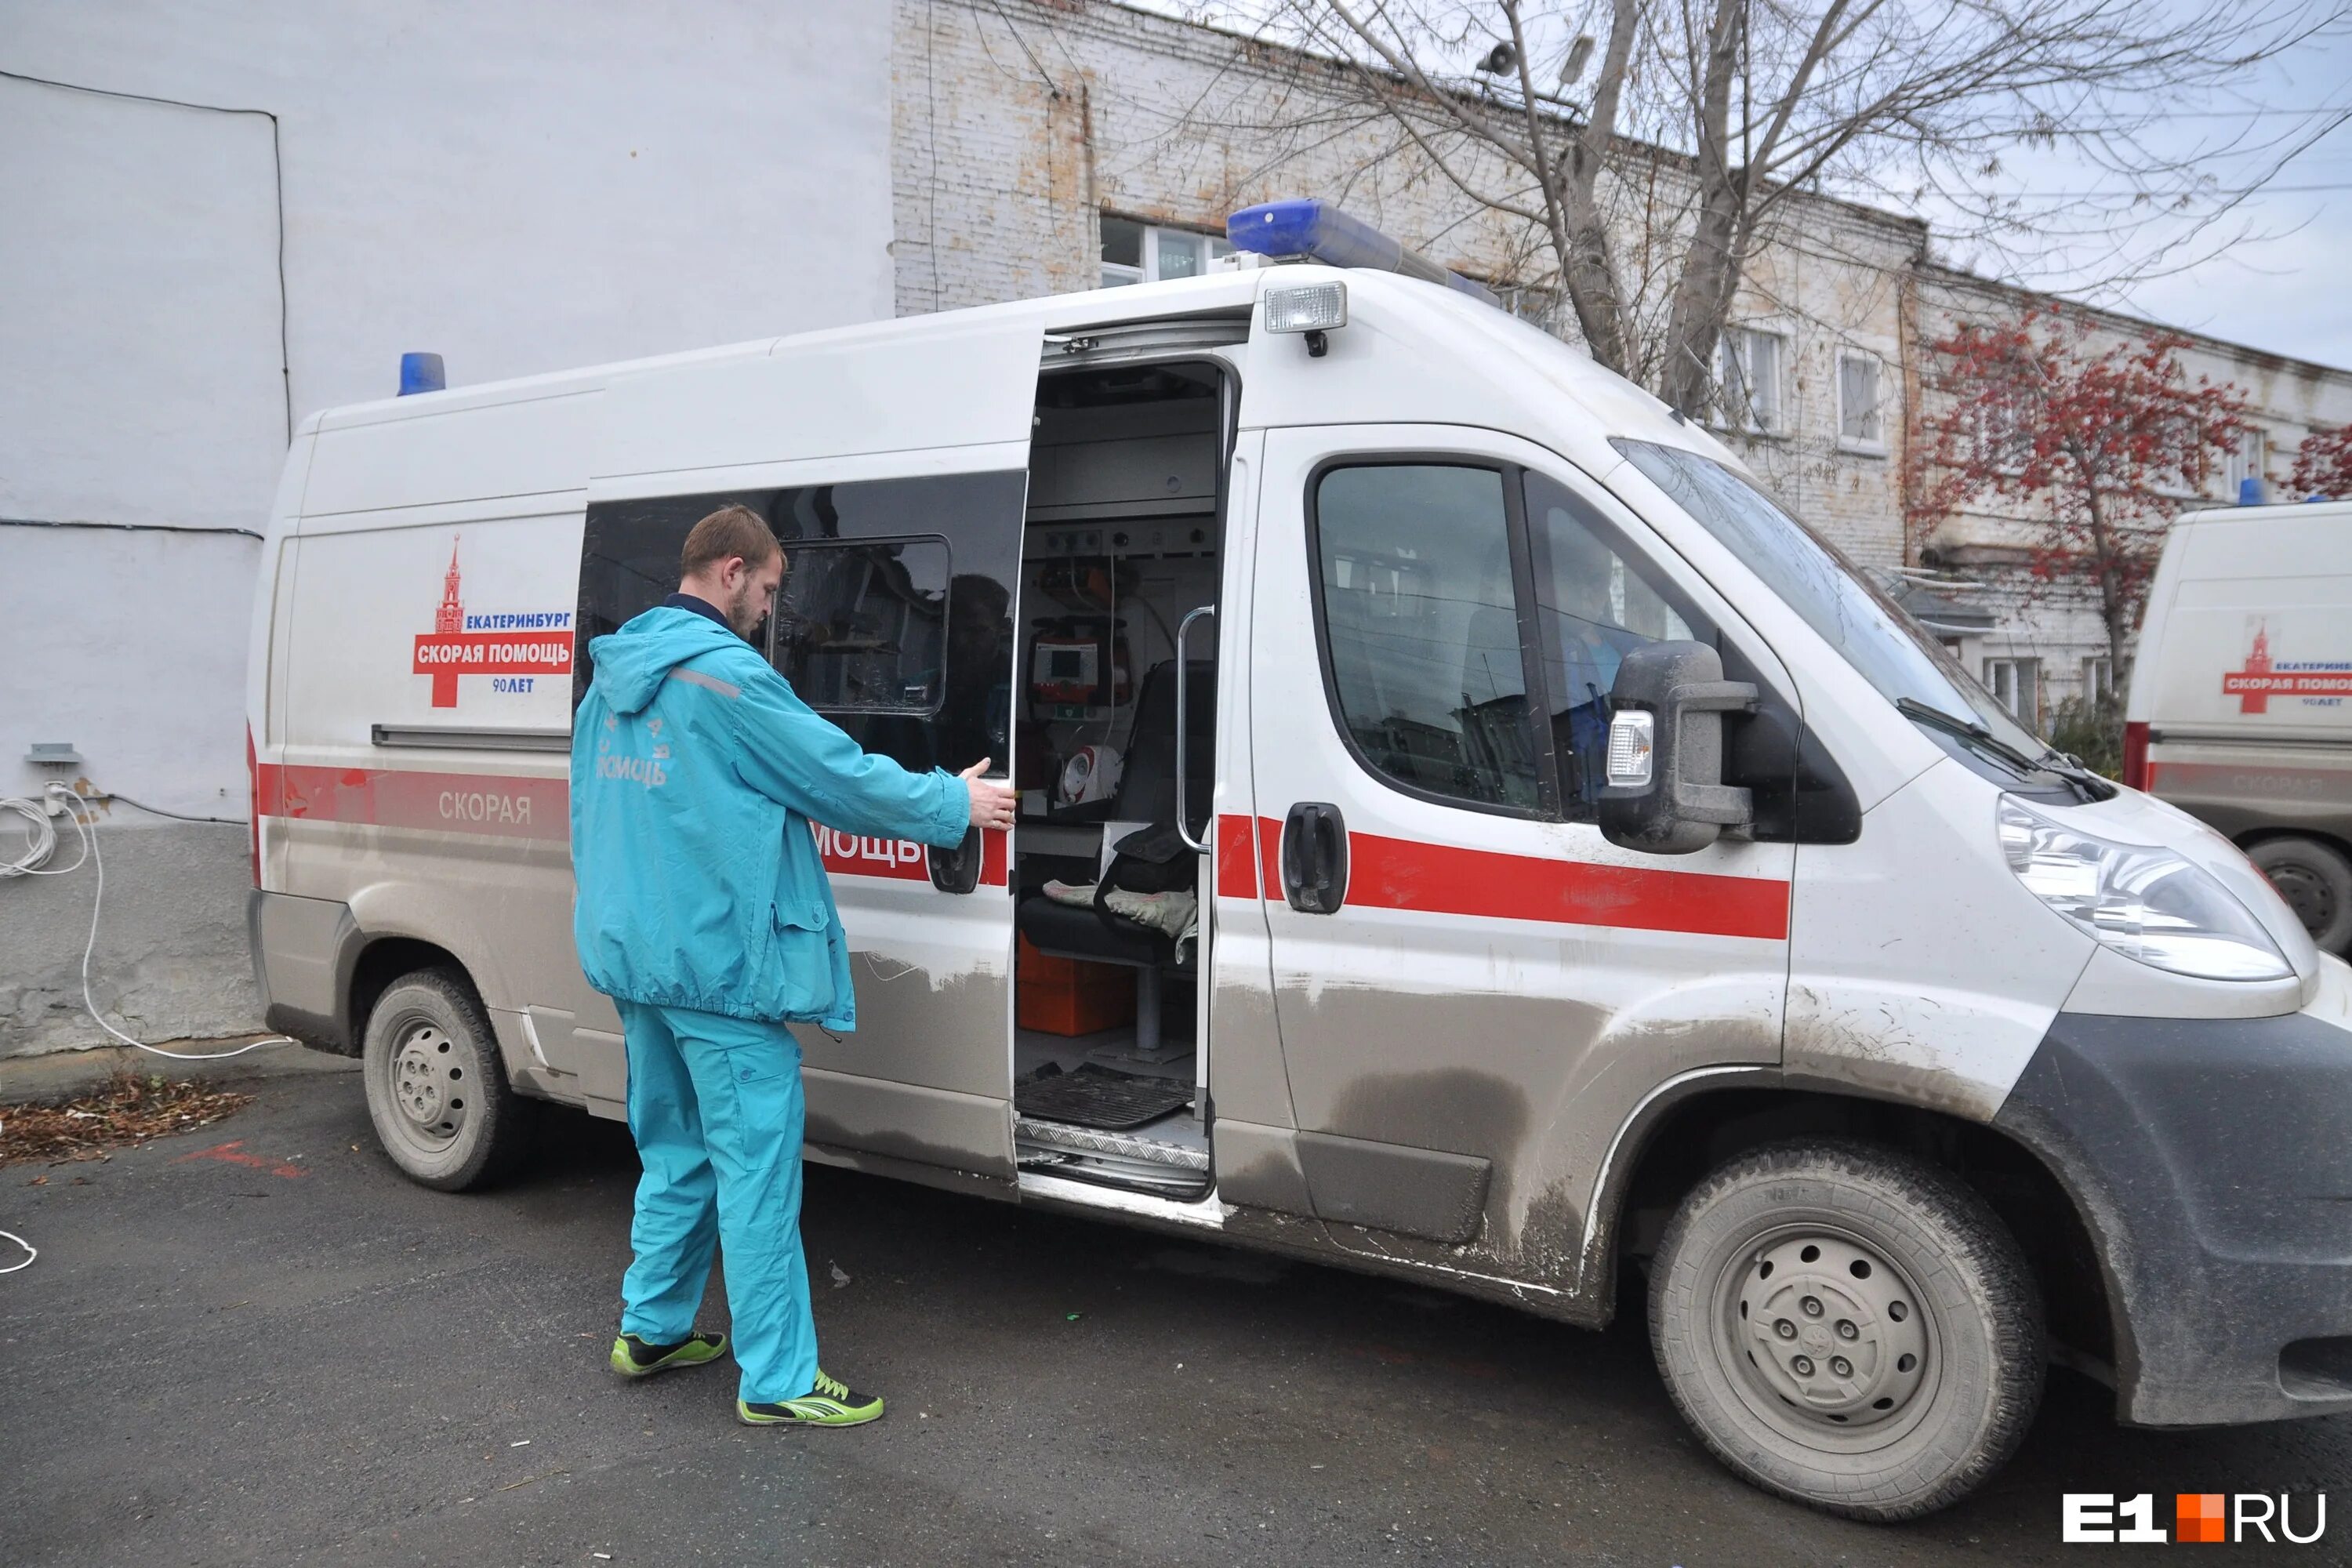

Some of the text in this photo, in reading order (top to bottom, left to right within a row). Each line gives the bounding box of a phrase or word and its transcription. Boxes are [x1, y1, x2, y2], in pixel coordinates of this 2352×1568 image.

[466, 612, 571, 630] ЕКАТЕРИНБУРГ
[417, 643, 570, 666] СКОРАЯ ПОМОЩЬ
[2227, 677, 2293, 690] СКОРАЯ
[439, 791, 532, 825] СКОРАЯ
